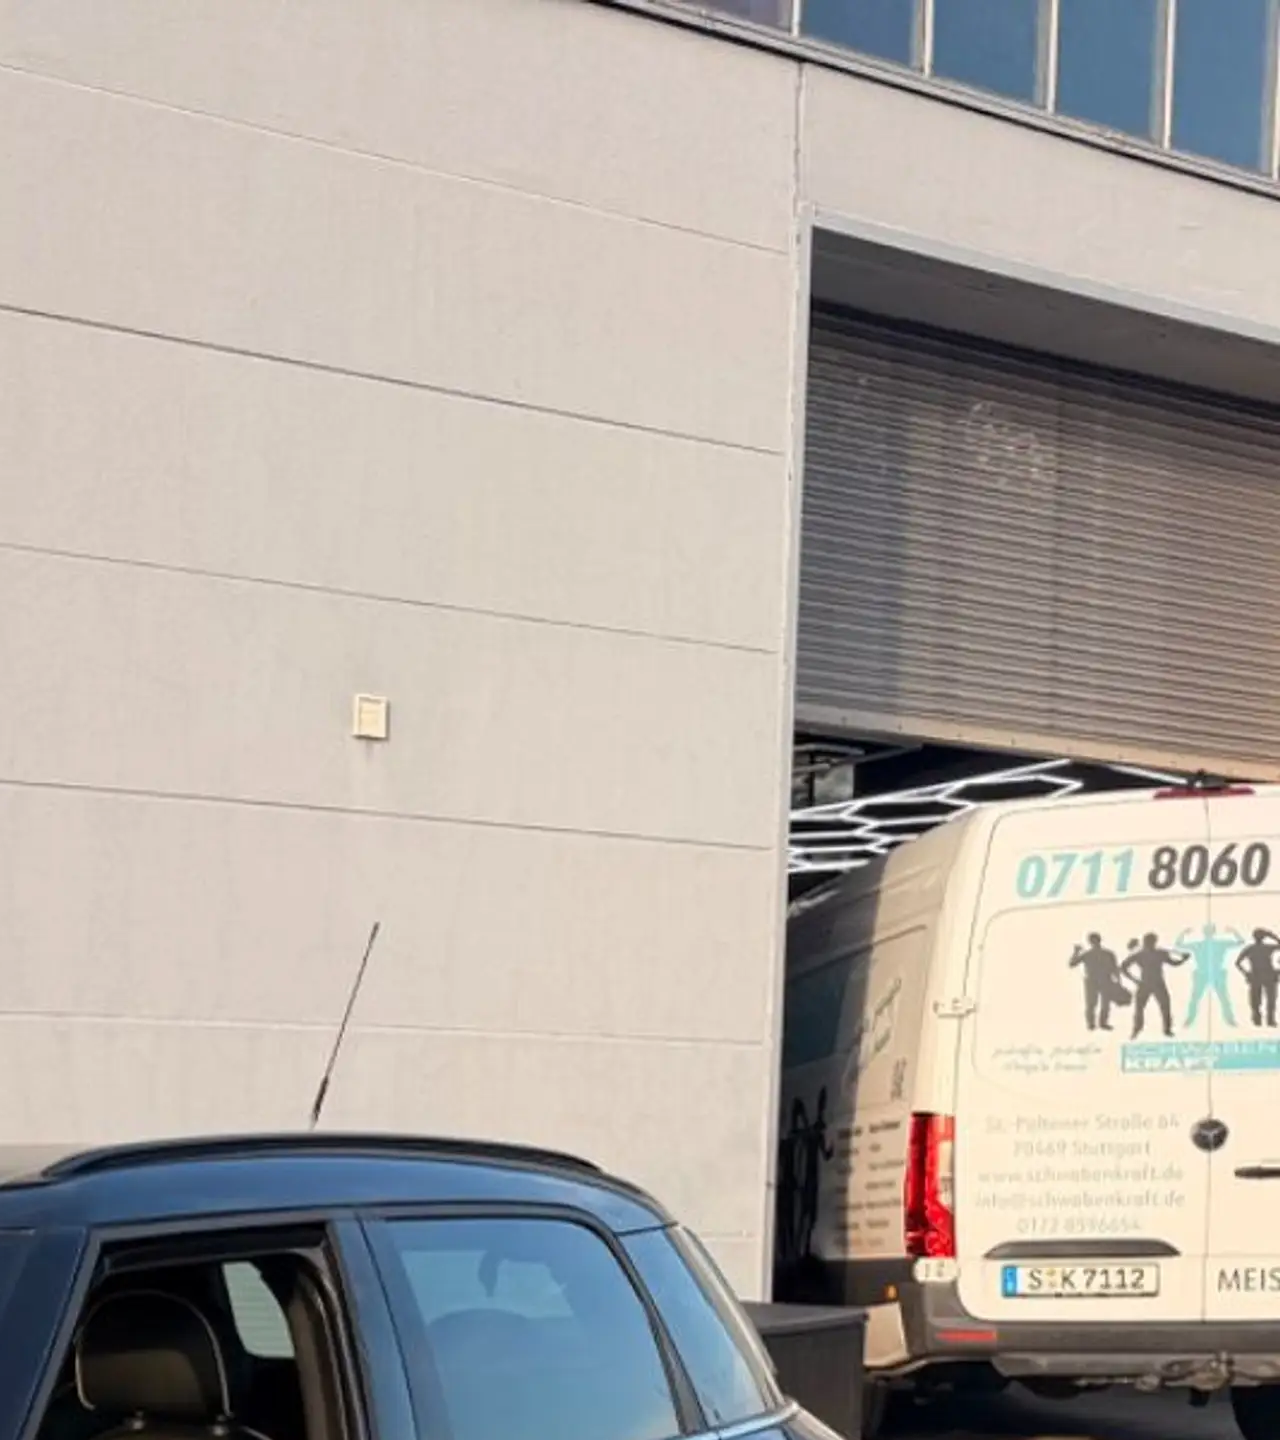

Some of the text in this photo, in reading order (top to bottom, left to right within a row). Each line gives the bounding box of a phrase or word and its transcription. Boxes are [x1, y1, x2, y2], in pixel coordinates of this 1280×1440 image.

[1016, 842, 1271, 898] 0711 8060
[1083, 1267, 1145, 1290] 7112
